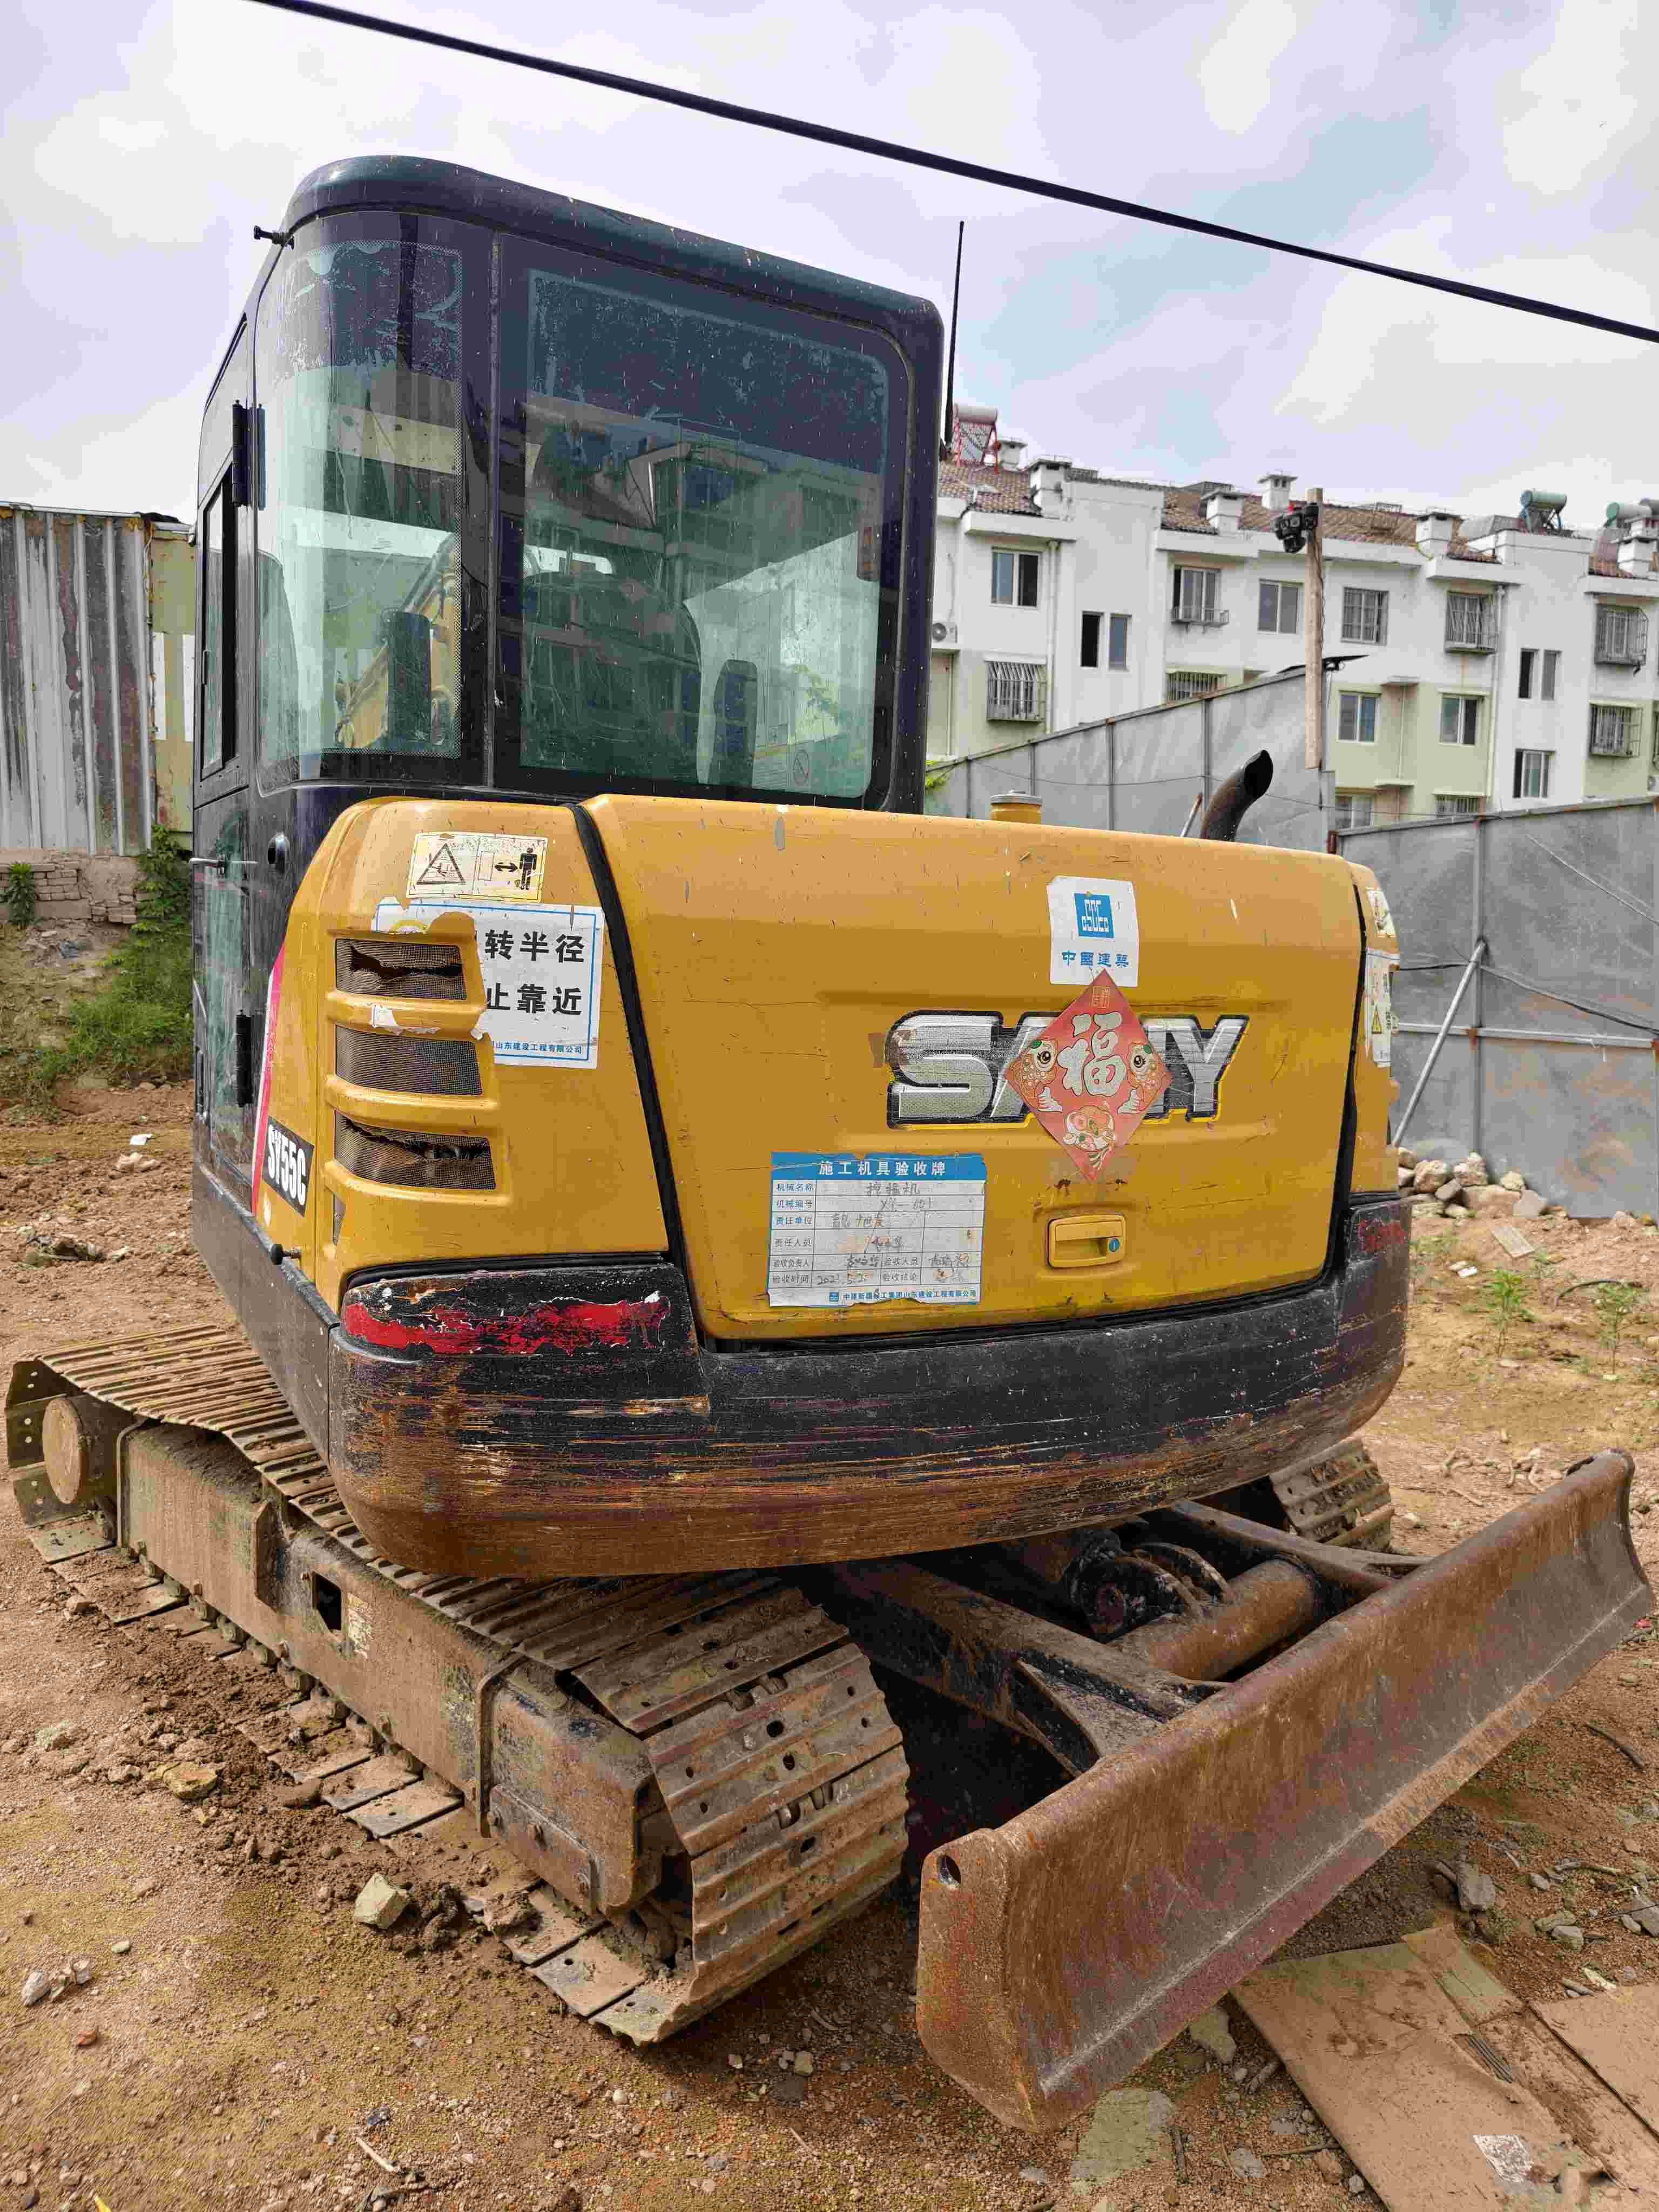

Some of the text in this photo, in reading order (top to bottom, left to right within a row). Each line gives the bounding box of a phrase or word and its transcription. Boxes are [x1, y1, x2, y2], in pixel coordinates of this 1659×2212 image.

[475, 929, 585, 963] 转半径
[487, 982, 582, 1016] 止靠近
[493, 1041, 582, 1054] 山东建设工程有限公司
[1057, 1010, 1129, 1097] 福
[885, 1010, 1250, 1129] SY
[819, 1161, 947, 1176] 施工机具验收牌
[777, 1183, 813, 1193] 机械名称
